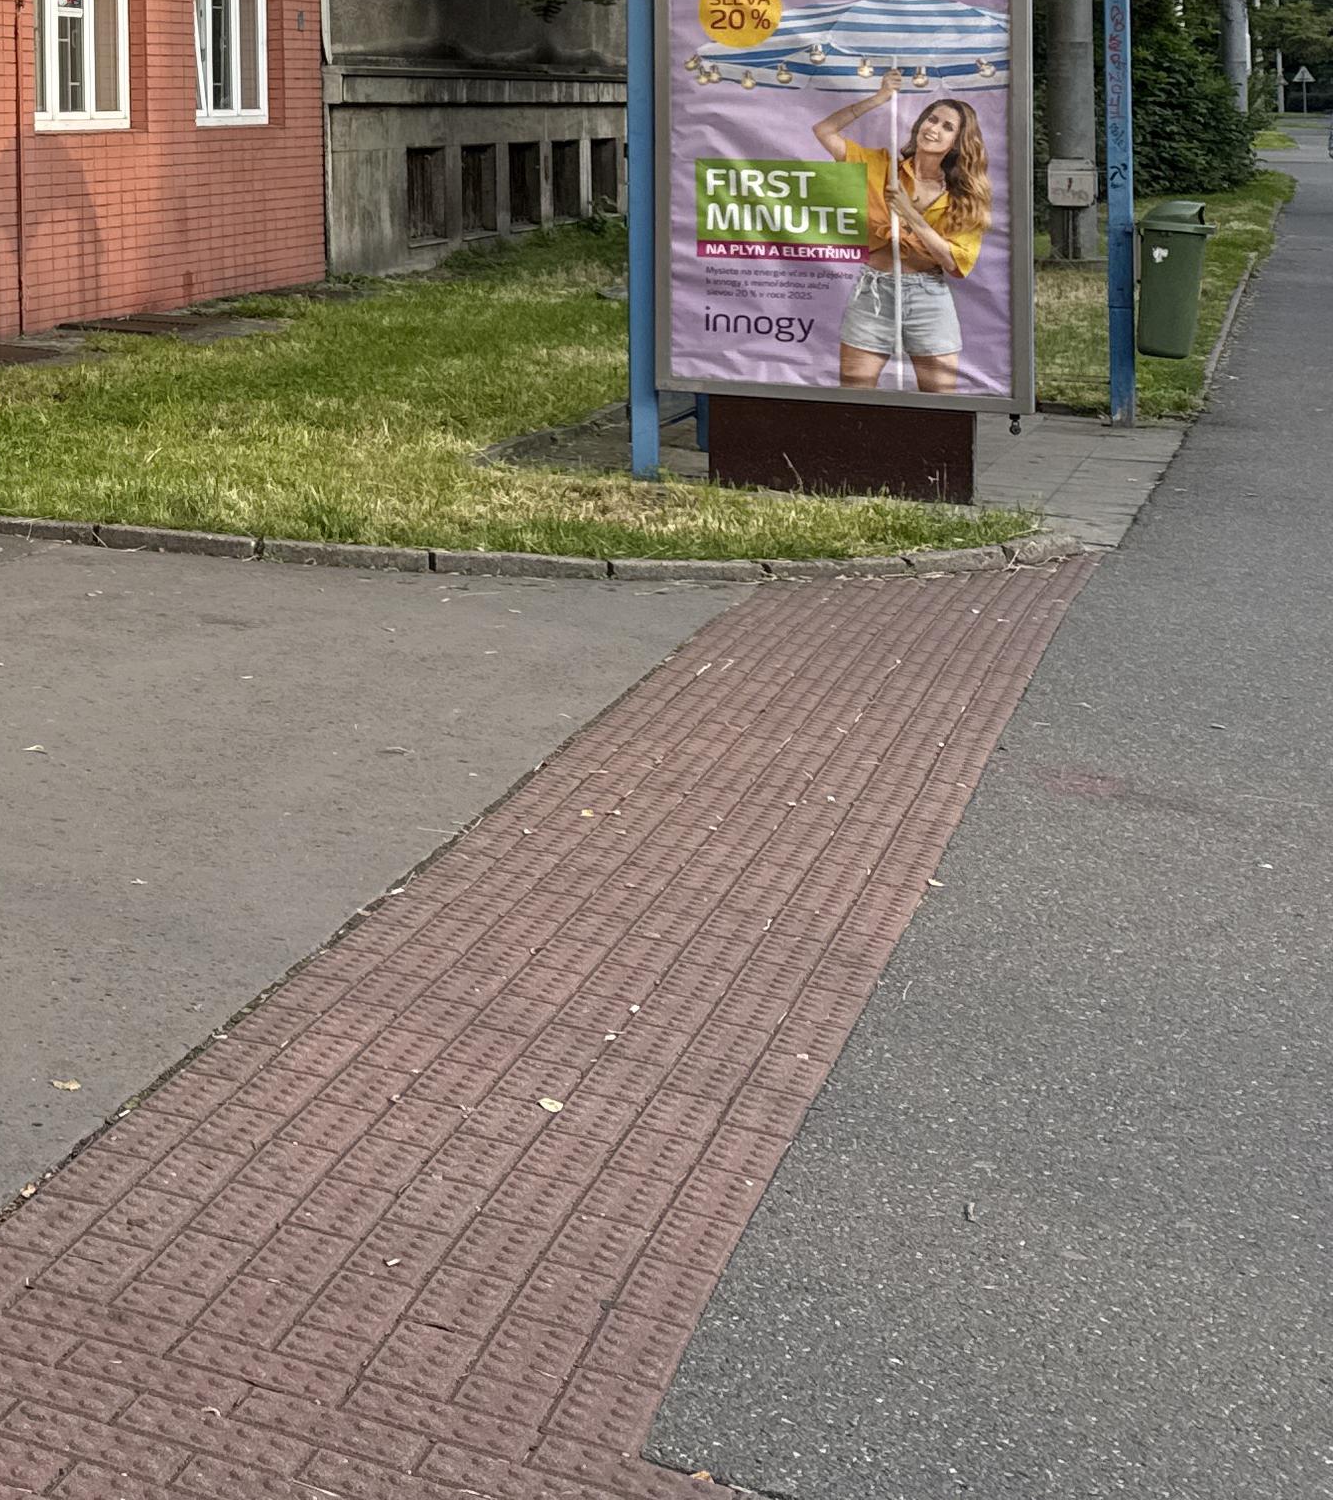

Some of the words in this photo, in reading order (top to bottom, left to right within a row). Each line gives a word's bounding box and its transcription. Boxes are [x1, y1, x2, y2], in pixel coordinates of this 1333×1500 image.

[710, 8, 745, 30] 20
[751, 8, 771, 30] %
[706, 168, 816, 199] FIRST
[706, 202, 859, 235] MINUTE
[705, 243, 727, 255] NA
[730, 244, 765, 256] PLYN
[768, 245, 780, 256] A
[783, 245, 861, 260] ELEKTŘINU
[705, 266, 739, 276] Myslete
[741, 268, 752, 276] na
[753, 268, 786, 278] energie
[735, 289, 749, 298] 20
[749, 289, 757, 298] %
[766, 291, 786, 300] roce
[787, 291, 813, 300] 2025
[704, 306, 815, 343] innogy
